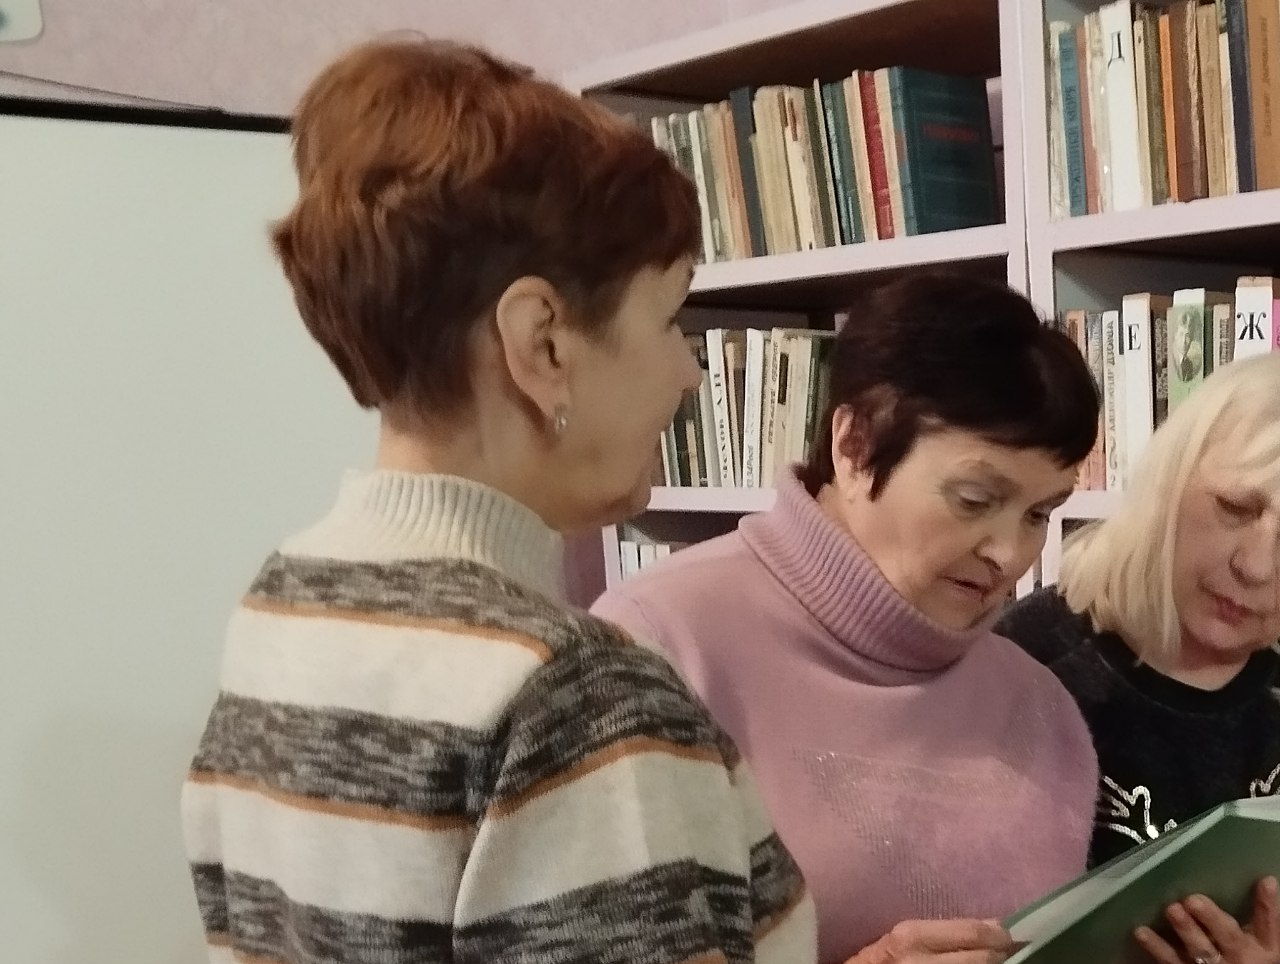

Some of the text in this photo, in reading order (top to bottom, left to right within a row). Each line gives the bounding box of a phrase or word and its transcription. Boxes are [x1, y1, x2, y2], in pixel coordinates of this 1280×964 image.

[1107, 30, 1126, 69] Д
[1127, 322, 1142, 351] Е
[1236, 311, 1267, 341] Ж
